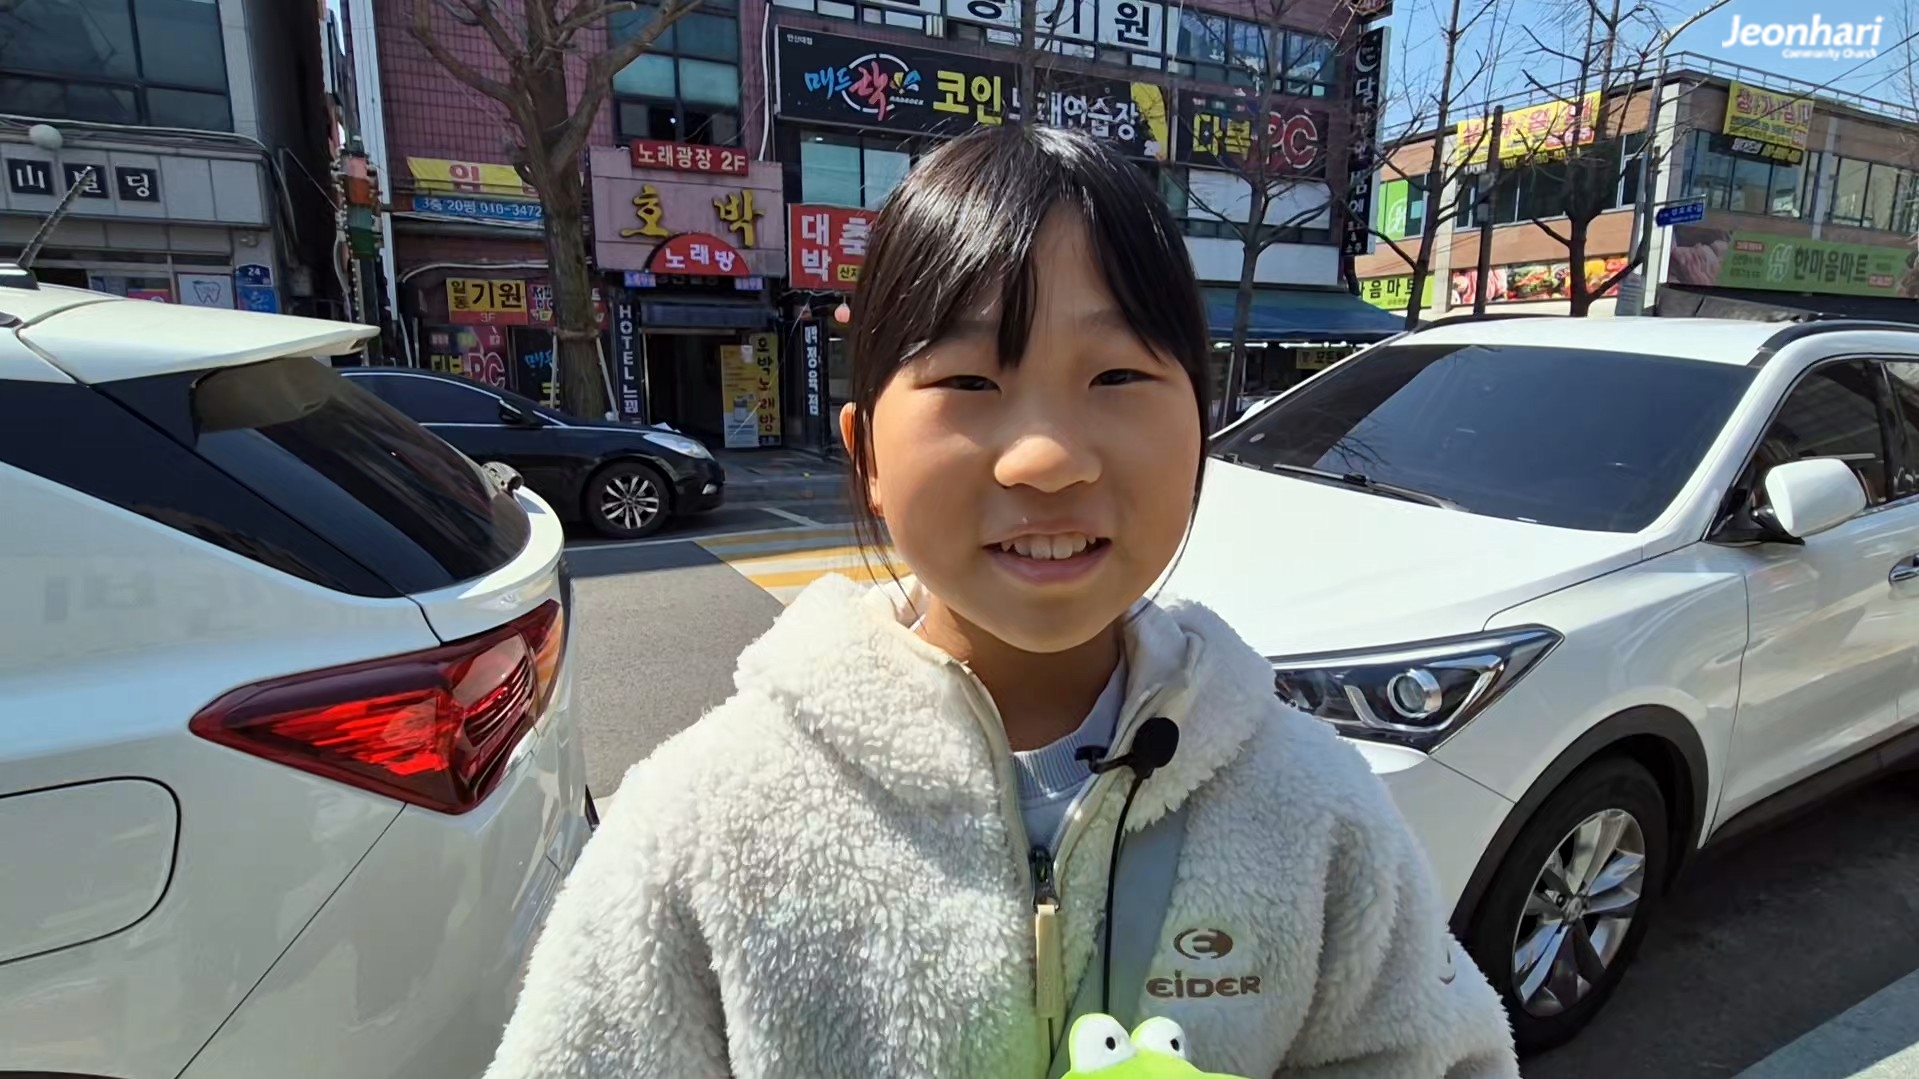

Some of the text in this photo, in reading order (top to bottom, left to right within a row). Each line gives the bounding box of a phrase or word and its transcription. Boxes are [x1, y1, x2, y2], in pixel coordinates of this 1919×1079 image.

[932, 69, 1003, 126] 코인
[638, 143, 746, 172] 노래광장 2F
[665, 243, 736, 272] 노래방
[1793, 246, 1868, 283] 한마음마트
[471, 282, 523, 309] 기원
[619, 304, 635, 380] HOTEL
